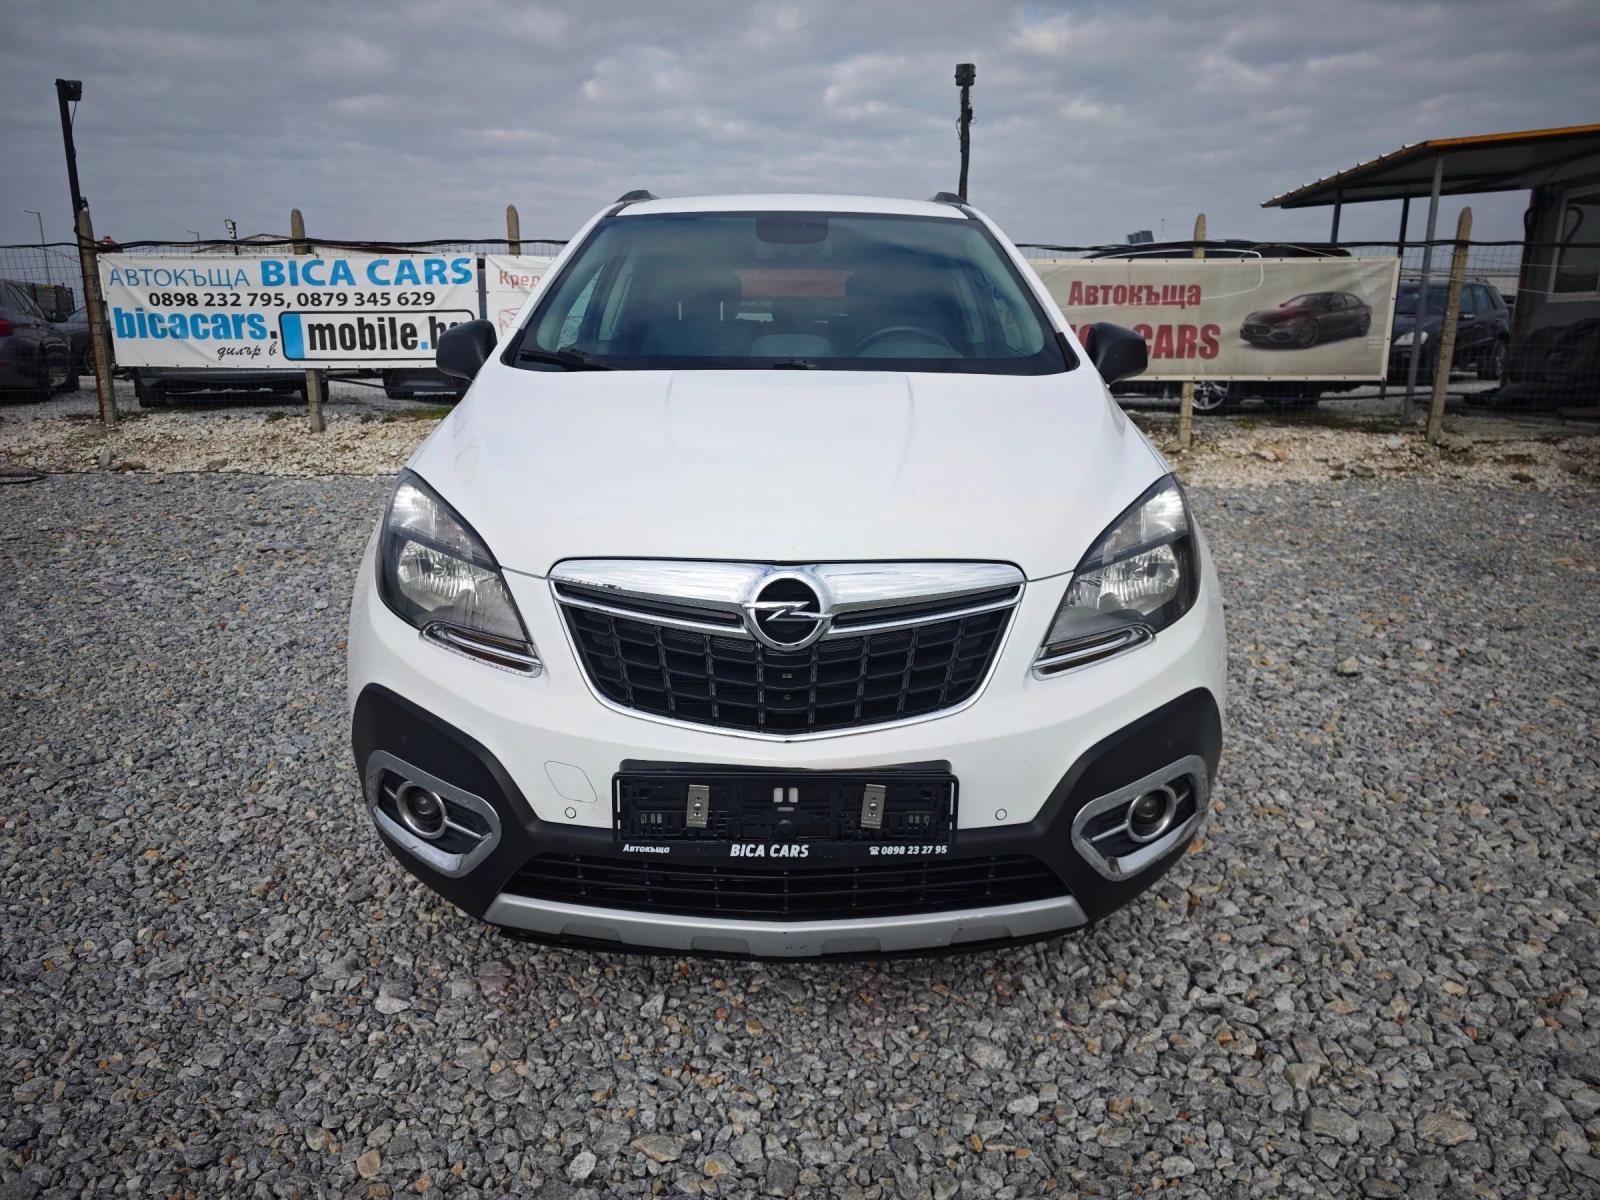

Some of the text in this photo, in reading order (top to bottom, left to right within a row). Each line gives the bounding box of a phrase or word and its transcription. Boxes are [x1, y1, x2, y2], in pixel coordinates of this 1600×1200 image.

[109, 257, 473, 290] АВТОКЪЩА BICA CARS
[149, 291, 436, 309] 0898 232 795, 0879 345 629
[1068, 280, 1202, 309] Автокъща
[113, 307, 278, 340] bicacars.
[307, 315, 464, 351] mobile.b
[1132, 323, 1221, 360] CARS
[622, 843, 810, 858] Автокъща BICA CARS
[880, 845, 948, 855] 0898 23 27 95
